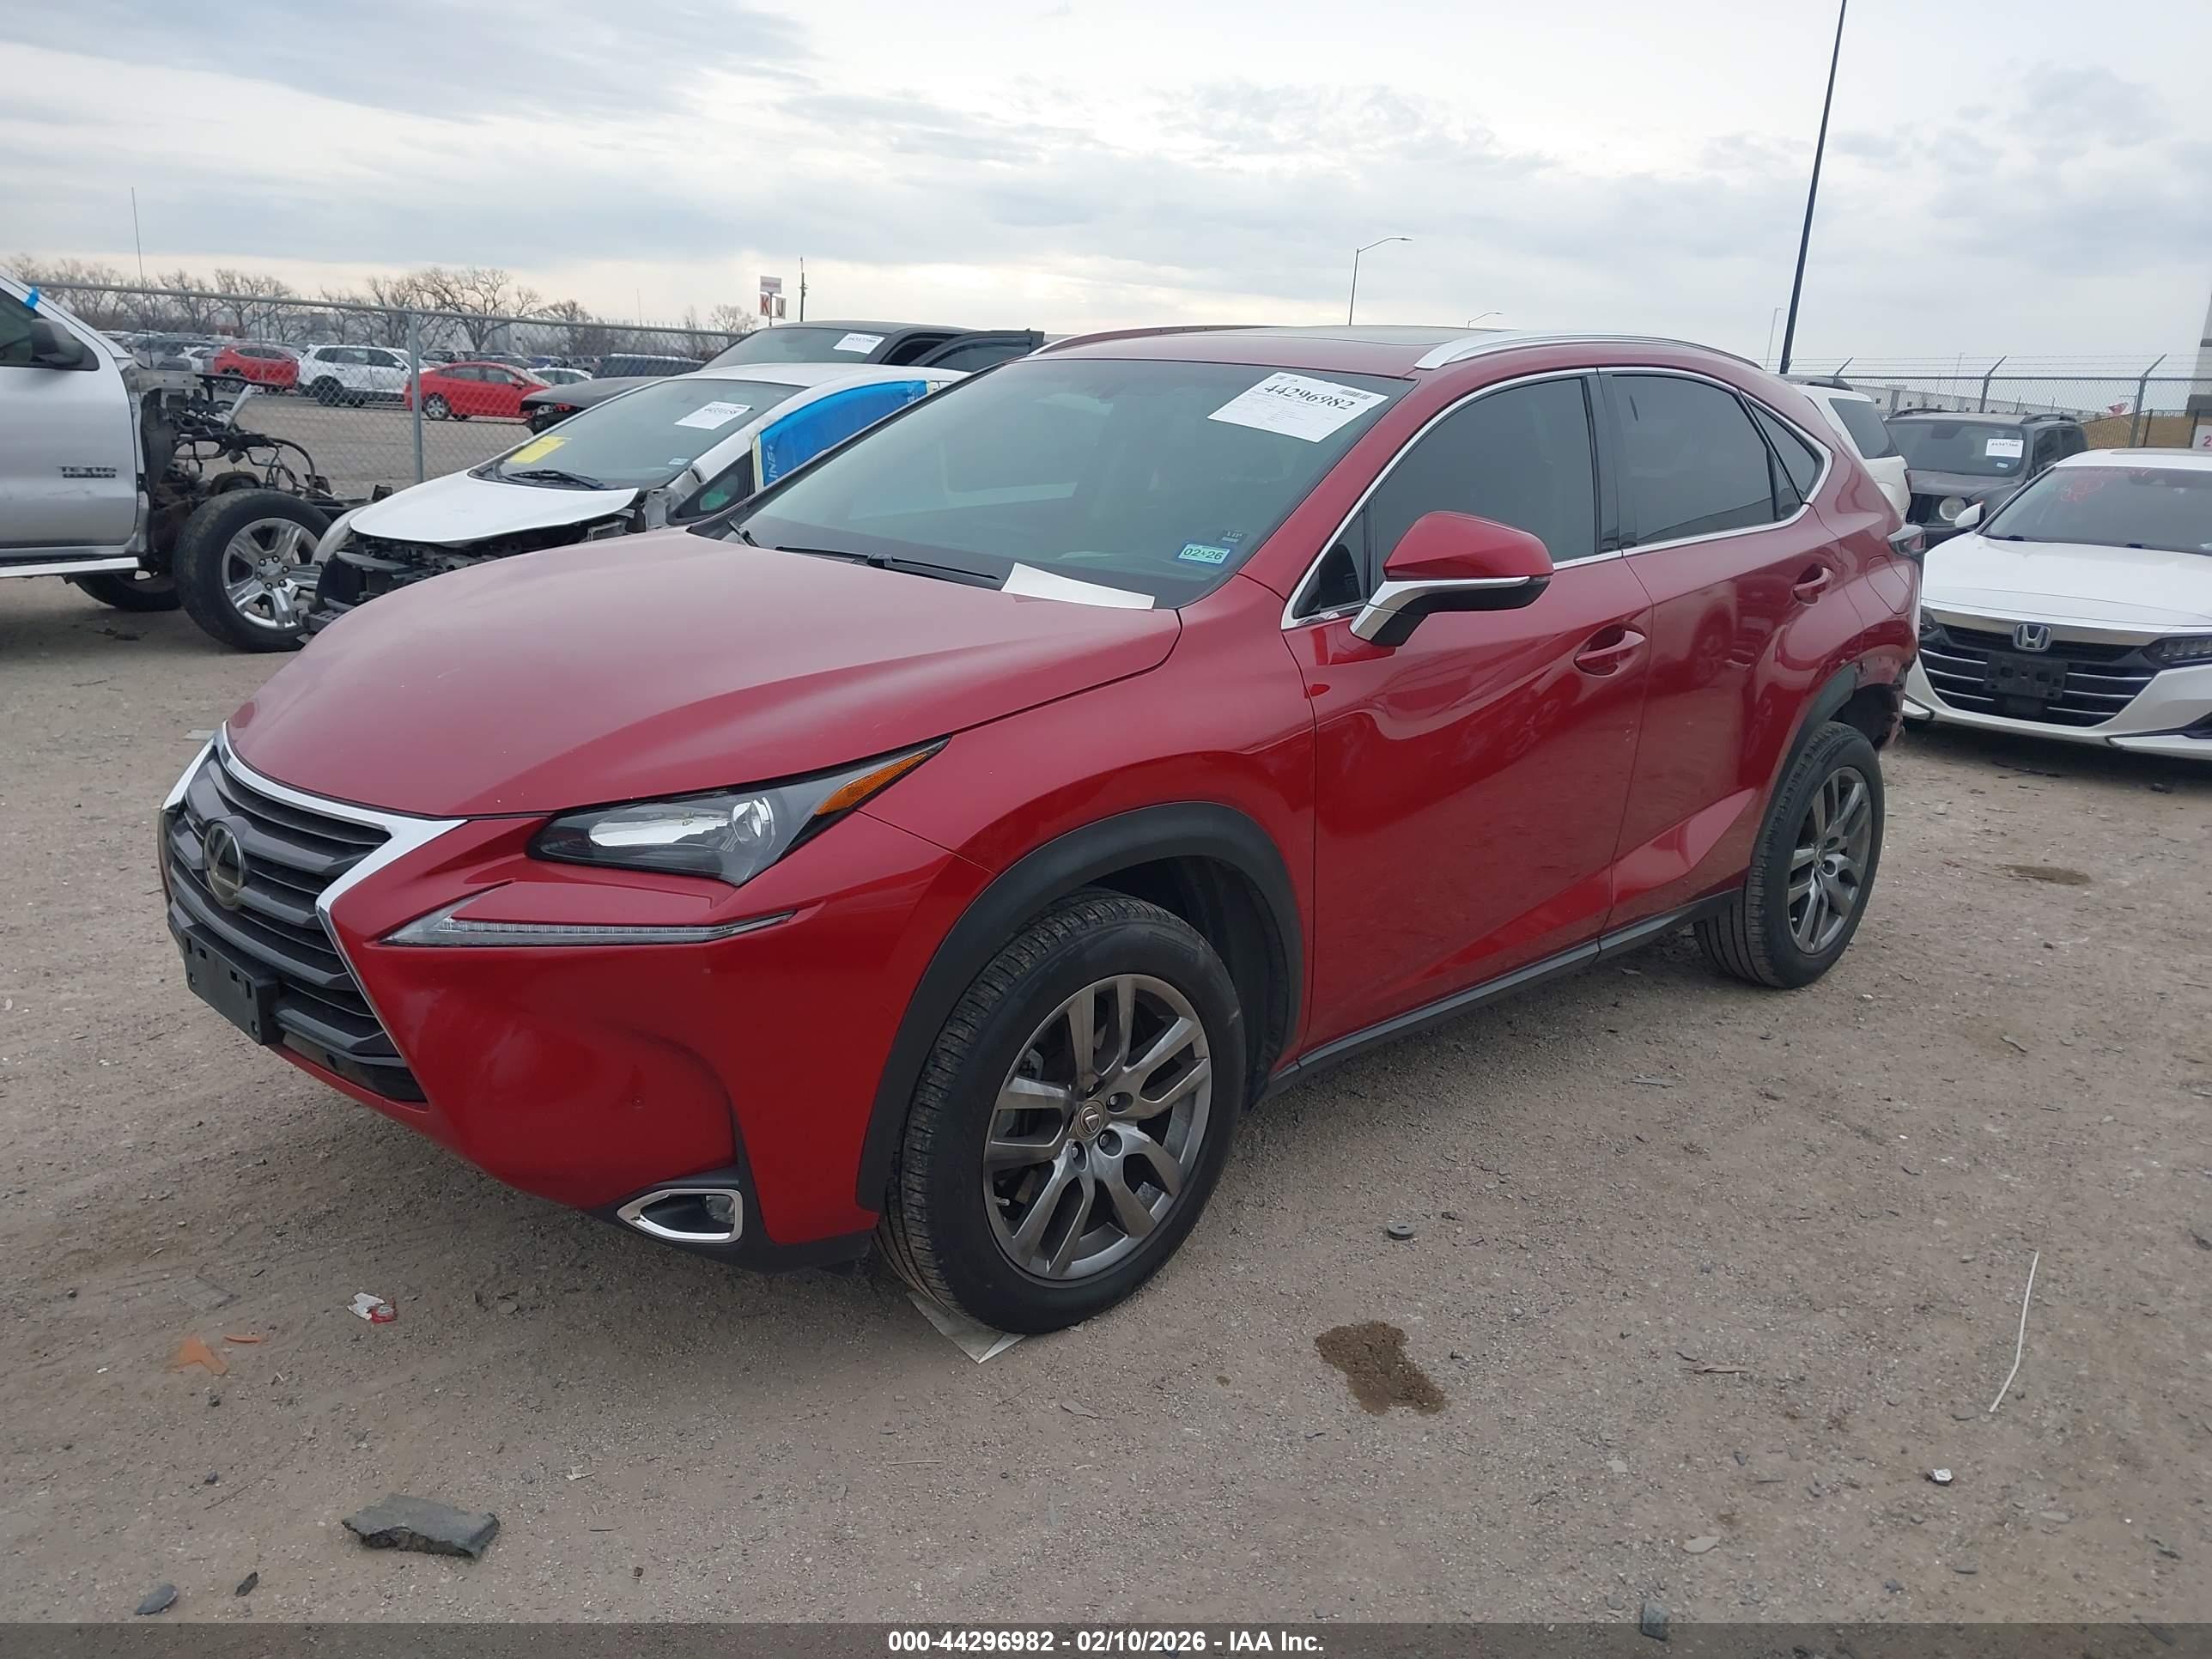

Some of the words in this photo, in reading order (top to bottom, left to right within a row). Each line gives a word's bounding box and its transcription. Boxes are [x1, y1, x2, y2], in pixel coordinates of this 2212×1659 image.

[761, 295, 769, 314] K
[1264, 384, 1357, 410] 44296982
[1183, 548, 1201, 557] 02
[1205, 550, 1224, 560] 26
